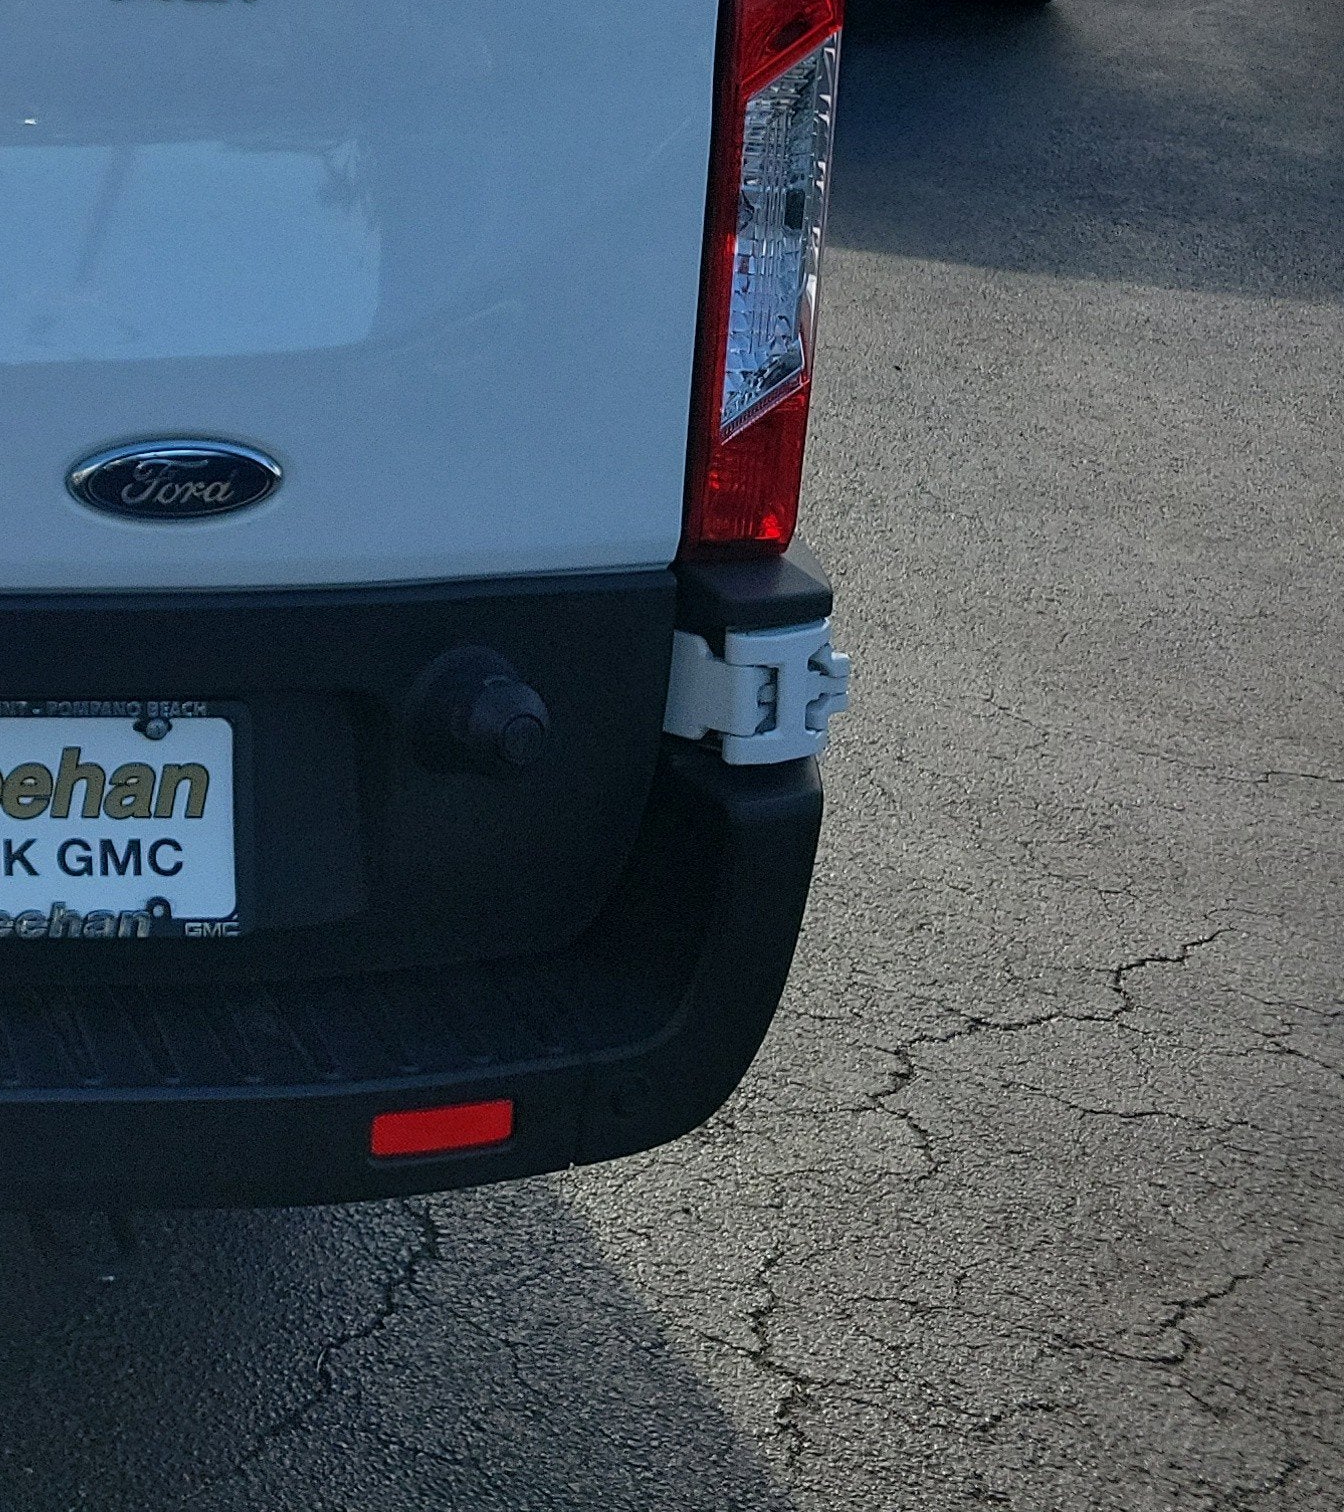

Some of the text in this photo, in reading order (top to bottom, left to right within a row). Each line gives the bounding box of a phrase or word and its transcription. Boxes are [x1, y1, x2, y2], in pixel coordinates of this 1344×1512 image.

[121, 457, 236, 505] Ford
[146, 700, 209, 717] BEACH
[55, 838, 184, 878] GMC
[185, 921, 240, 938] GMC
